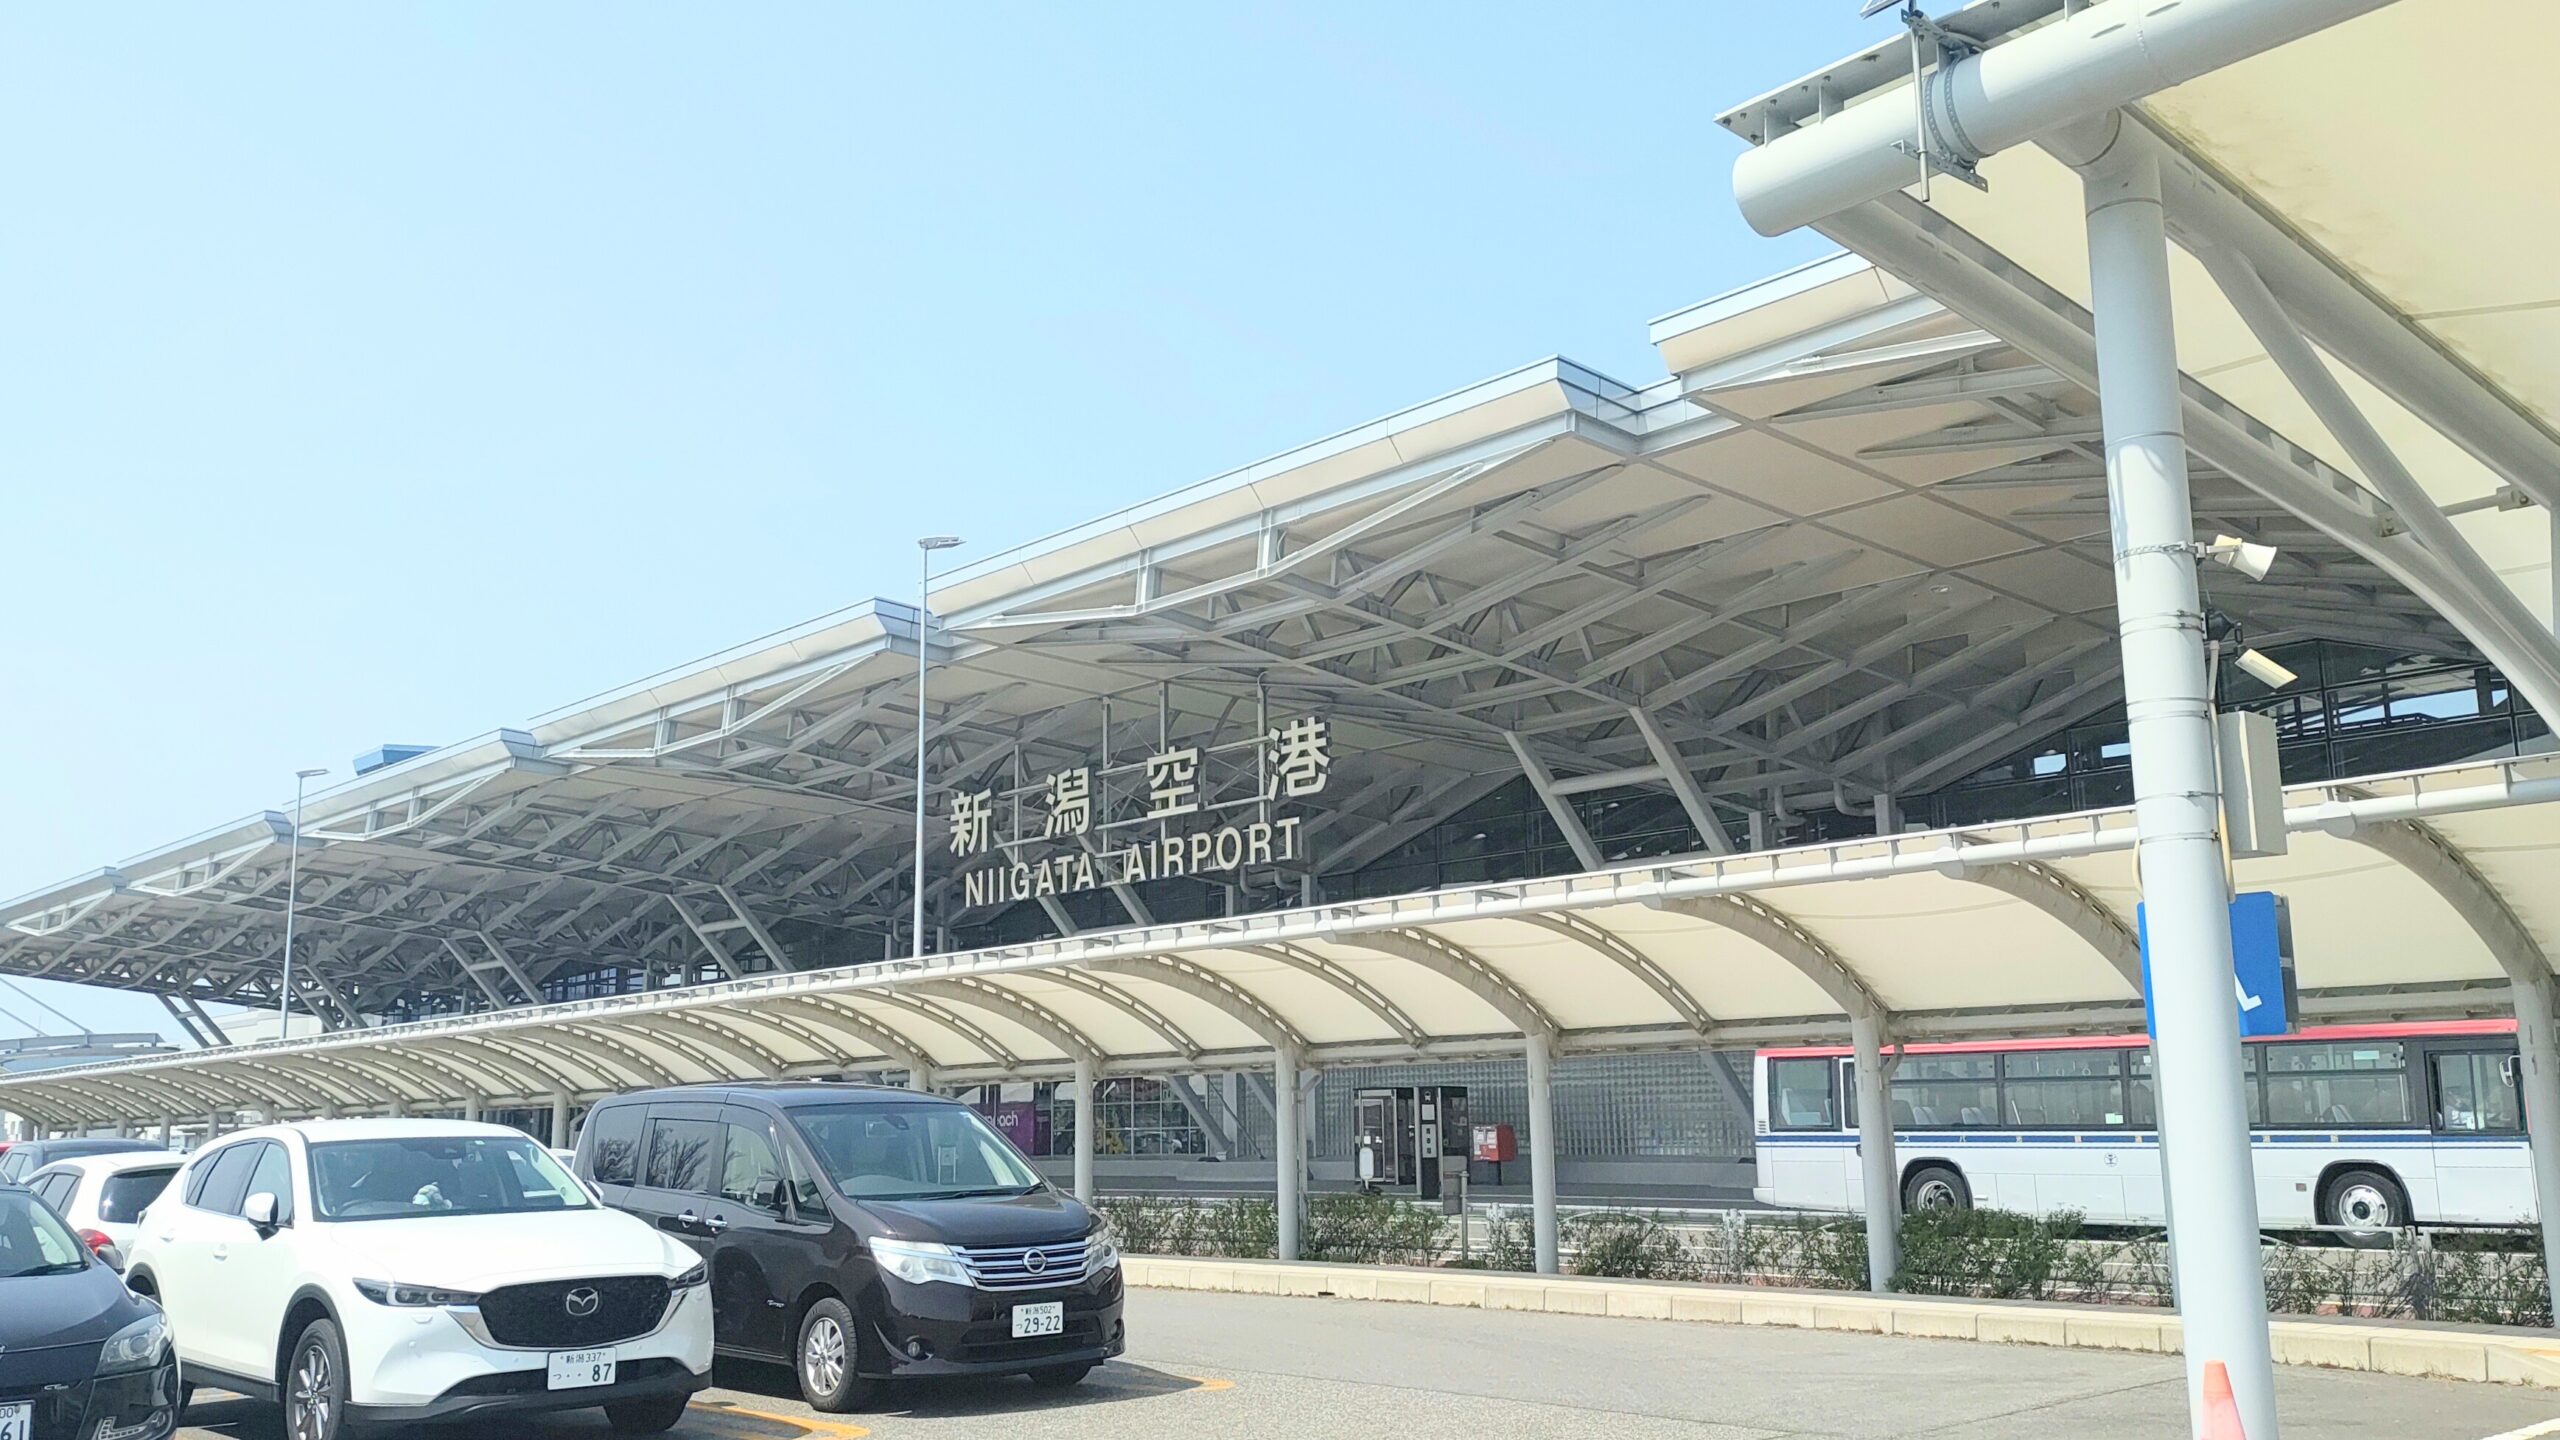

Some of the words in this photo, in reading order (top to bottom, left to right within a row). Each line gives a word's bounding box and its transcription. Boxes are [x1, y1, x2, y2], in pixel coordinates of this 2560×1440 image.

[950, 716, 1331, 857] 新潟空港
[965, 852, 1096, 908] NIIGATA
[1126, 816, 1300, 884] AIRPORT
[1024, 1315, 1060, 1334] 29-22
